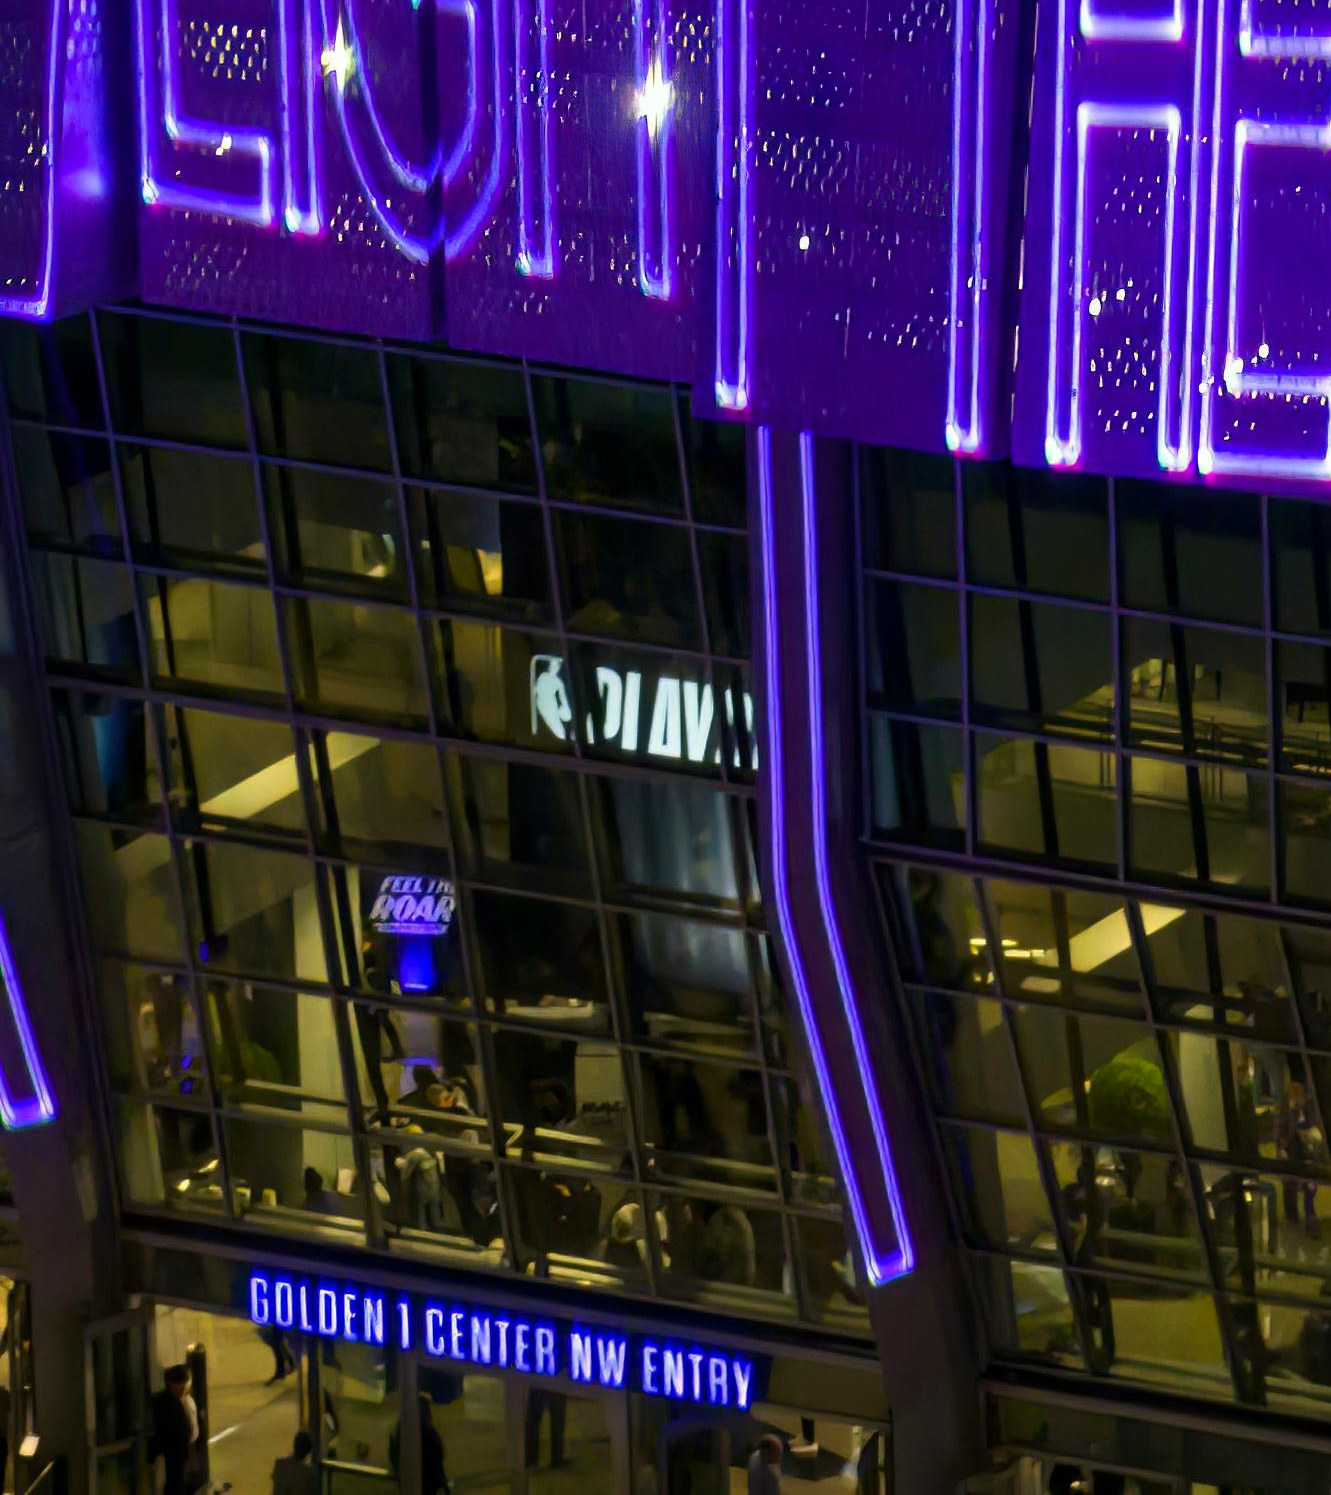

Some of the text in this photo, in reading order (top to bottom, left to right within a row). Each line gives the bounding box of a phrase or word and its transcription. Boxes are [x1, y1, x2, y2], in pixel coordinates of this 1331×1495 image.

[370, 895, 456, 922] ROAR
[250, 1277, 752, 1410] GOLDEN 1 CENTER NW ENTRY
